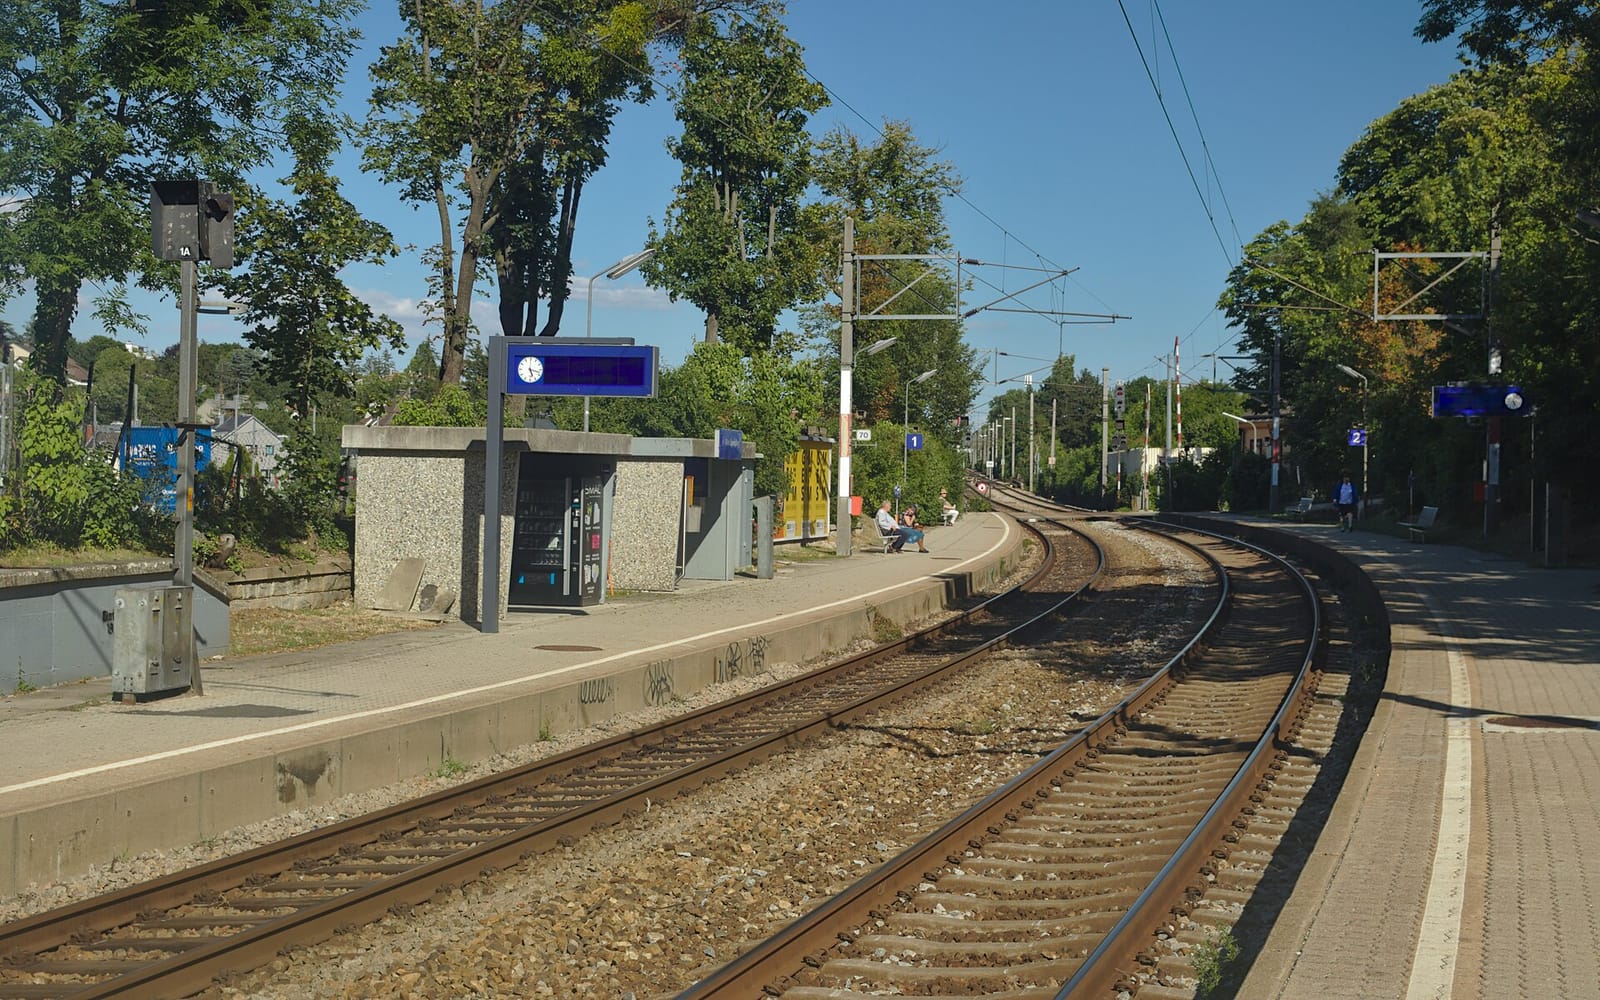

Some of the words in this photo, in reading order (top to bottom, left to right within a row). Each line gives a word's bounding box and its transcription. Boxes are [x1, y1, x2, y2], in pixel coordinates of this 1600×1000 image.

[180, 247, 191, 256] 1A
[911, 436, 917, 447] 1
[1353, 432, 1361, 443] 2
